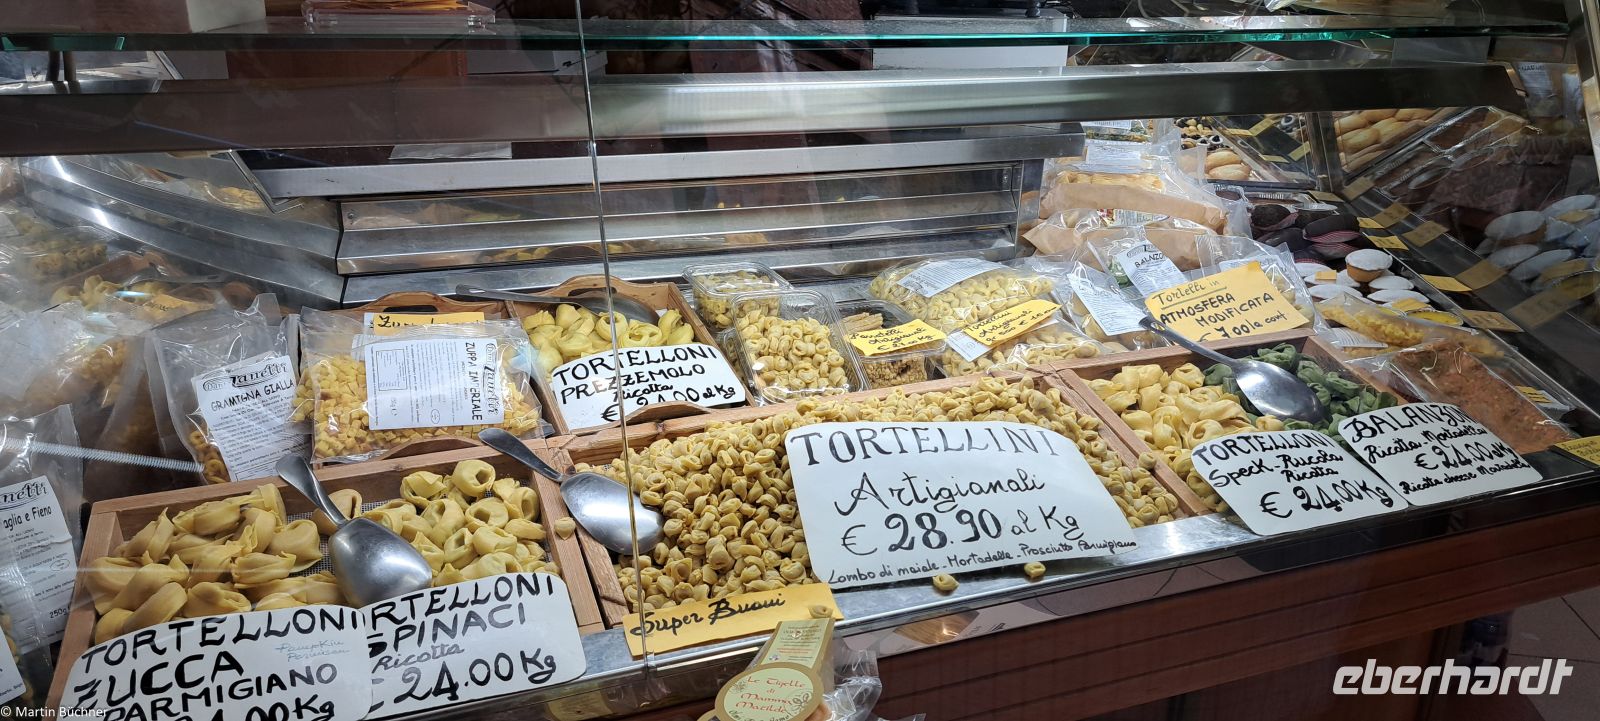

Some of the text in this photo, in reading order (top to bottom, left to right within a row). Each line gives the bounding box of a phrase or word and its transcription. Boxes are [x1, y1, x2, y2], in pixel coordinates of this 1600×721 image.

[1160, 292, 1236, 324] ATMOSFERA
[1195, 292, 1275, 327] MODIFICATA
[230, 362, 288, 386] Zanetti
[464, 341, 483, 421] ZUPPA IMERIALE
[553, 345, 717, 387] TORTELLONI
[211, 378, 295, 412] GRAMIGNA GIALLA
[561, 363, 705, 404] PREZZEMOLO
[613, 383, 674, 403] Ricotta
[714, 385, 736, 400] Kg
[790, 426, 1060, 466] TORTELLINI
[1193, 432, 1336, 466] TORTELLONI
[1363, 438, 1423, 464] Ricotta
[1413, 453, 1439, 471] €
[1209, 457, 1274, 488] Speck
[1276, 450, 1344, 470] Rucola
[1280, 466, 1339, 483] Ricotta
[1398, 477, 1444, 495] Ricotta
[0, 482, 48, 503] netti
[834, 467, 1045, 517] Artigianali
[1259, 491, 1293, 519] €
[2, 504, 52, 532] aglia e Fieno
[840, 505, 1086, 555] € 28.90 al Kg
[828, 569, 876, 585] Lombo
[879, 563, 894, 578] di
[898, 558, 940, 577] maiale
[49, 607, 68, 619] 250g
[363, 573, 554, 631] RTELLONI
[630, 593, 786, 636] Super Buoni
[81, 607, 359, 674] TORTELLONI
[371, 643, 465, 674] Ricotta
[68, 651, 244, 718] ZUCCA
[393, 652, 514, 704] 24.00
[519, 648, 557, 685] Kg
